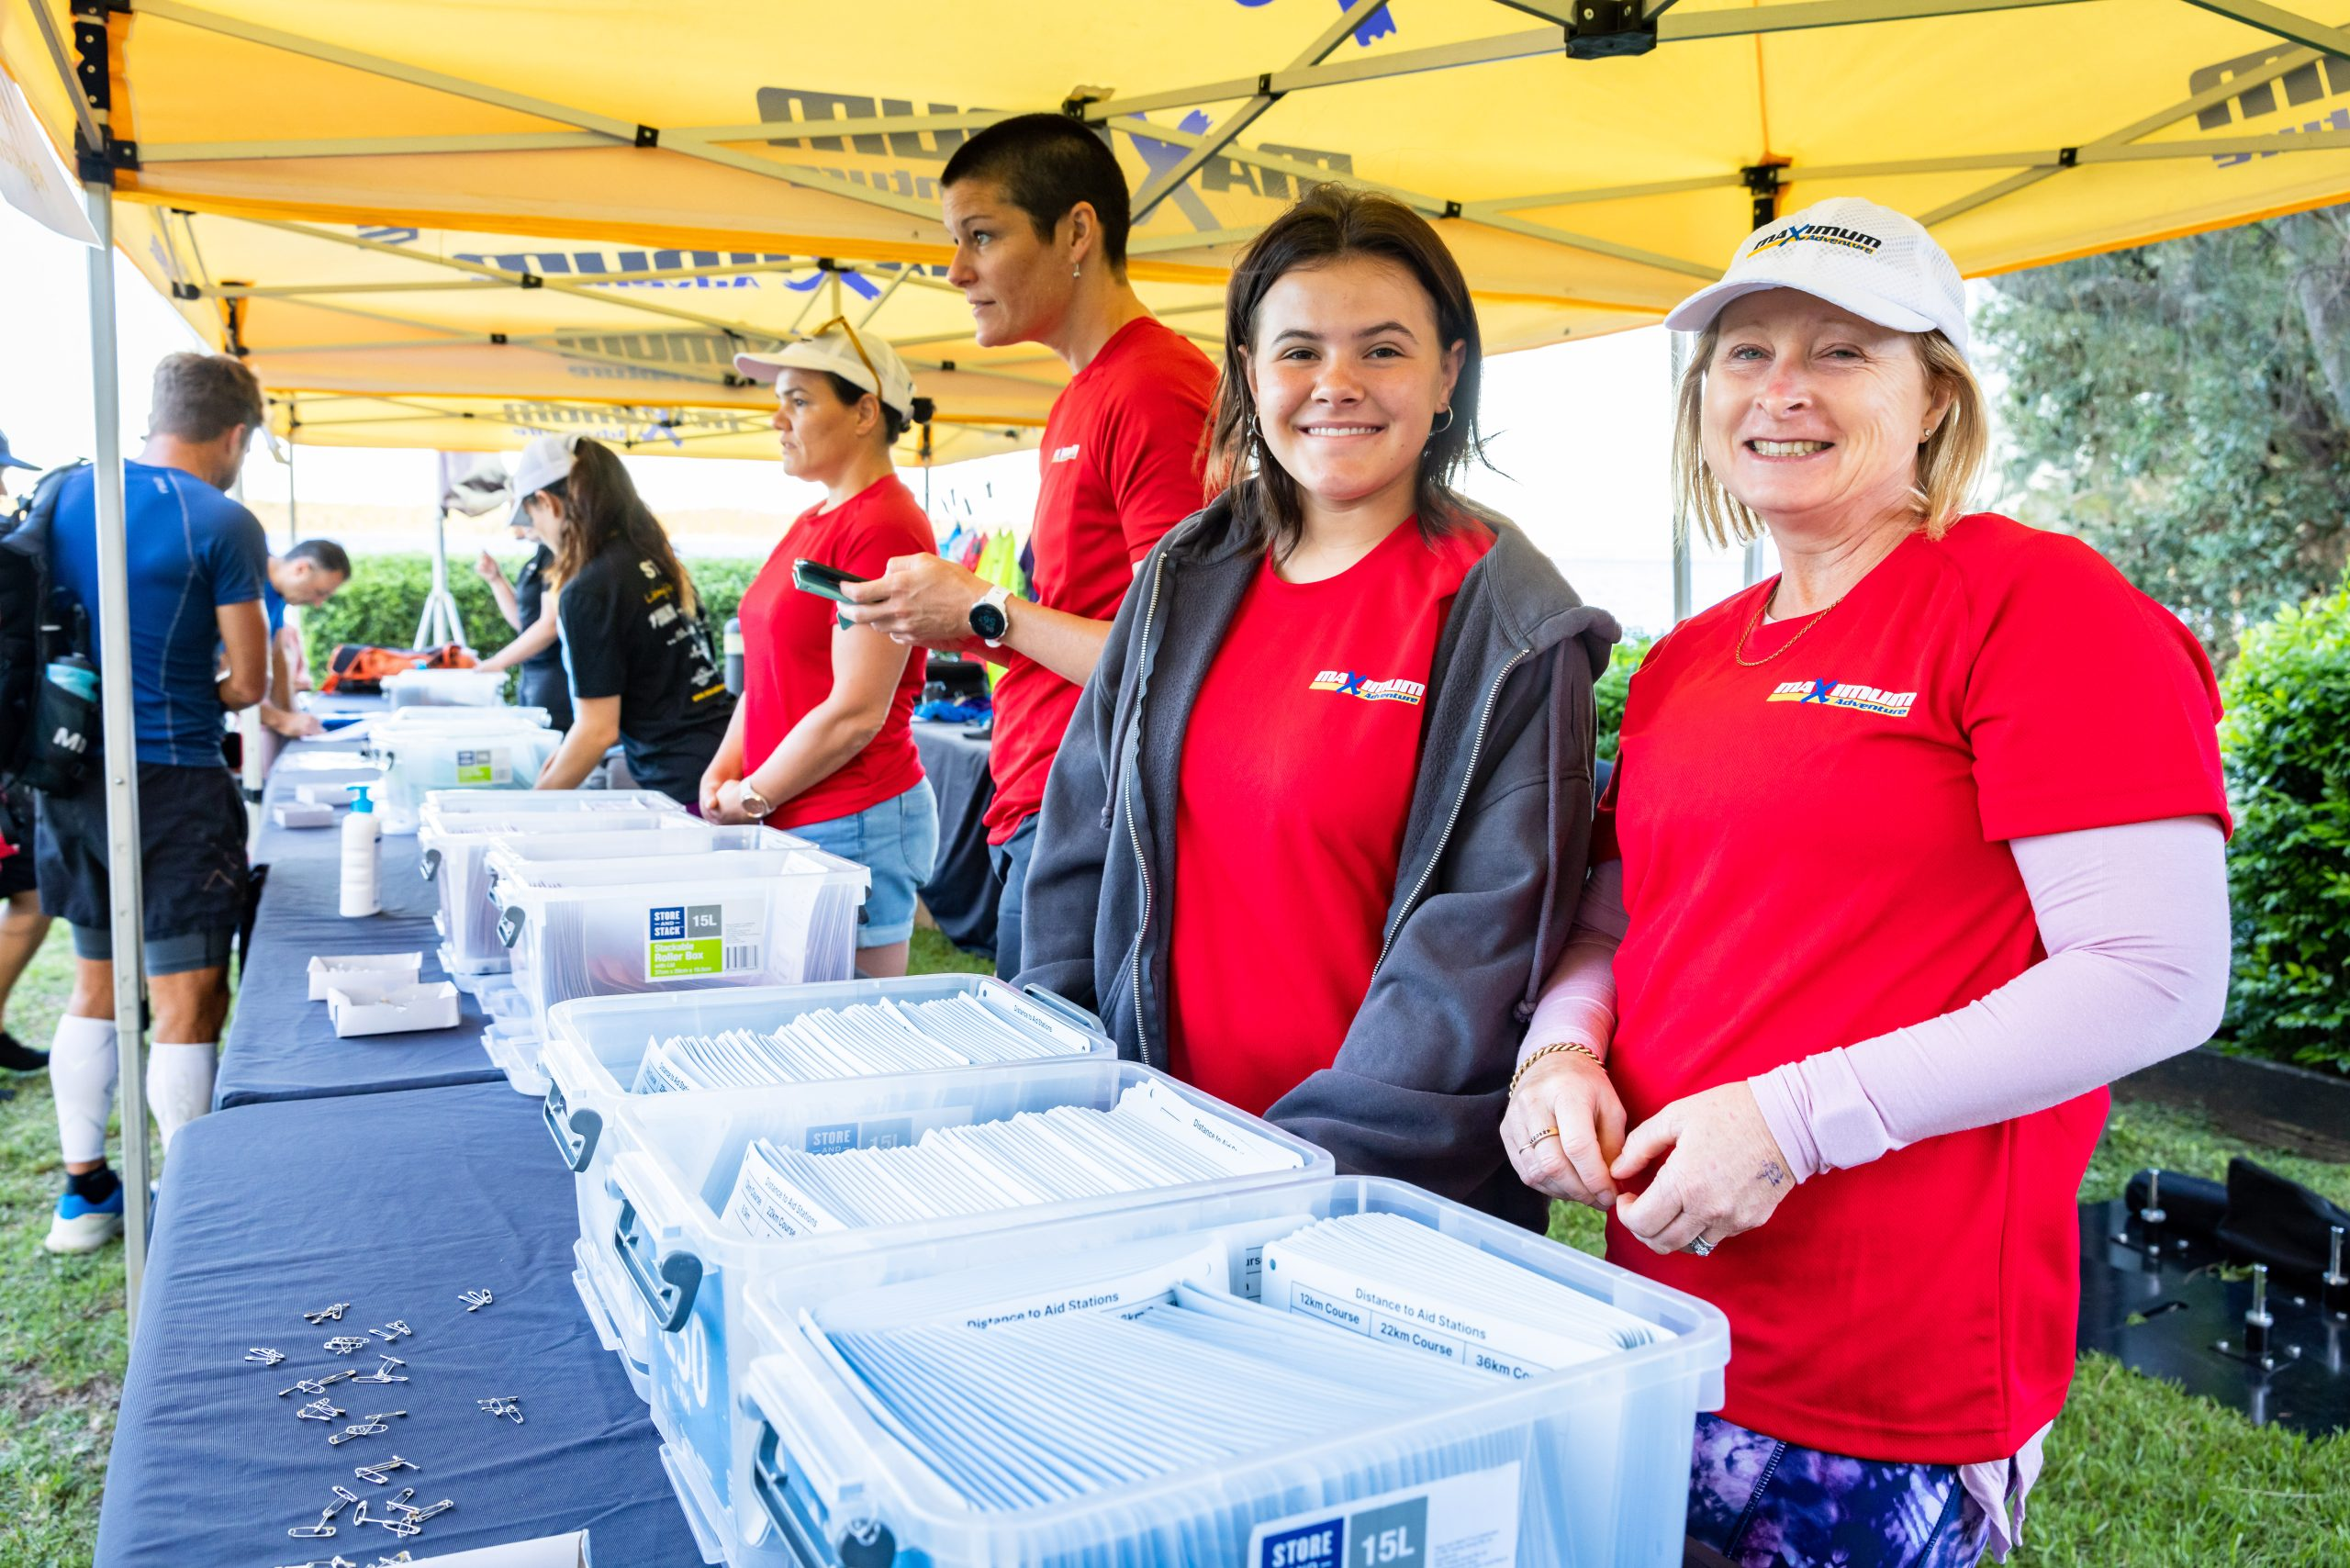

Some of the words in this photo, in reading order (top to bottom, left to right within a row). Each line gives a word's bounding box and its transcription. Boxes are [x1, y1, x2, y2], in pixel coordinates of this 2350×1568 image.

[1805, 235, 1874, 254] Adventure
[1364, 692, 1418, 703] Adenture
[1834, 698, 1908, 715] Adventure
[654, 911, 680, 921] STORE
[692, 914, 717, 927] 15L
[655, 953, 683, 963] Roller
[685, 951, 704, 960] Box
[813, 1130, 851, 1146] STORE
[1193, 1118, 1215, 1139] Distance
[796, 1204, 818, 1228] Stations
[1028, 1308, 1041, 1320] to
[1045, 1302, 1066, 1317] Aid
[1069, 1292, 1119, 1311] Stations
[1300, 1292, 1324, 1311] 12km
[1325, 1303, 1360, 1325] Course
[1356, 1288, 1401, 1313] Distance
[1404, 1305, 1415, 1316] to
[1417, 1309, 1436, 1324] Aid
[1438, 1315, 1487, 1340] Stations
[1380, 1322, 1410, 1343] 22km
[1412, 1333, 1453, 1357] Course
[1476, 1354, 1511, 1376] 36km
[1272, 1530, 1334, 1568] STORE
[1361, 1526, 1416, 1567] 15L
